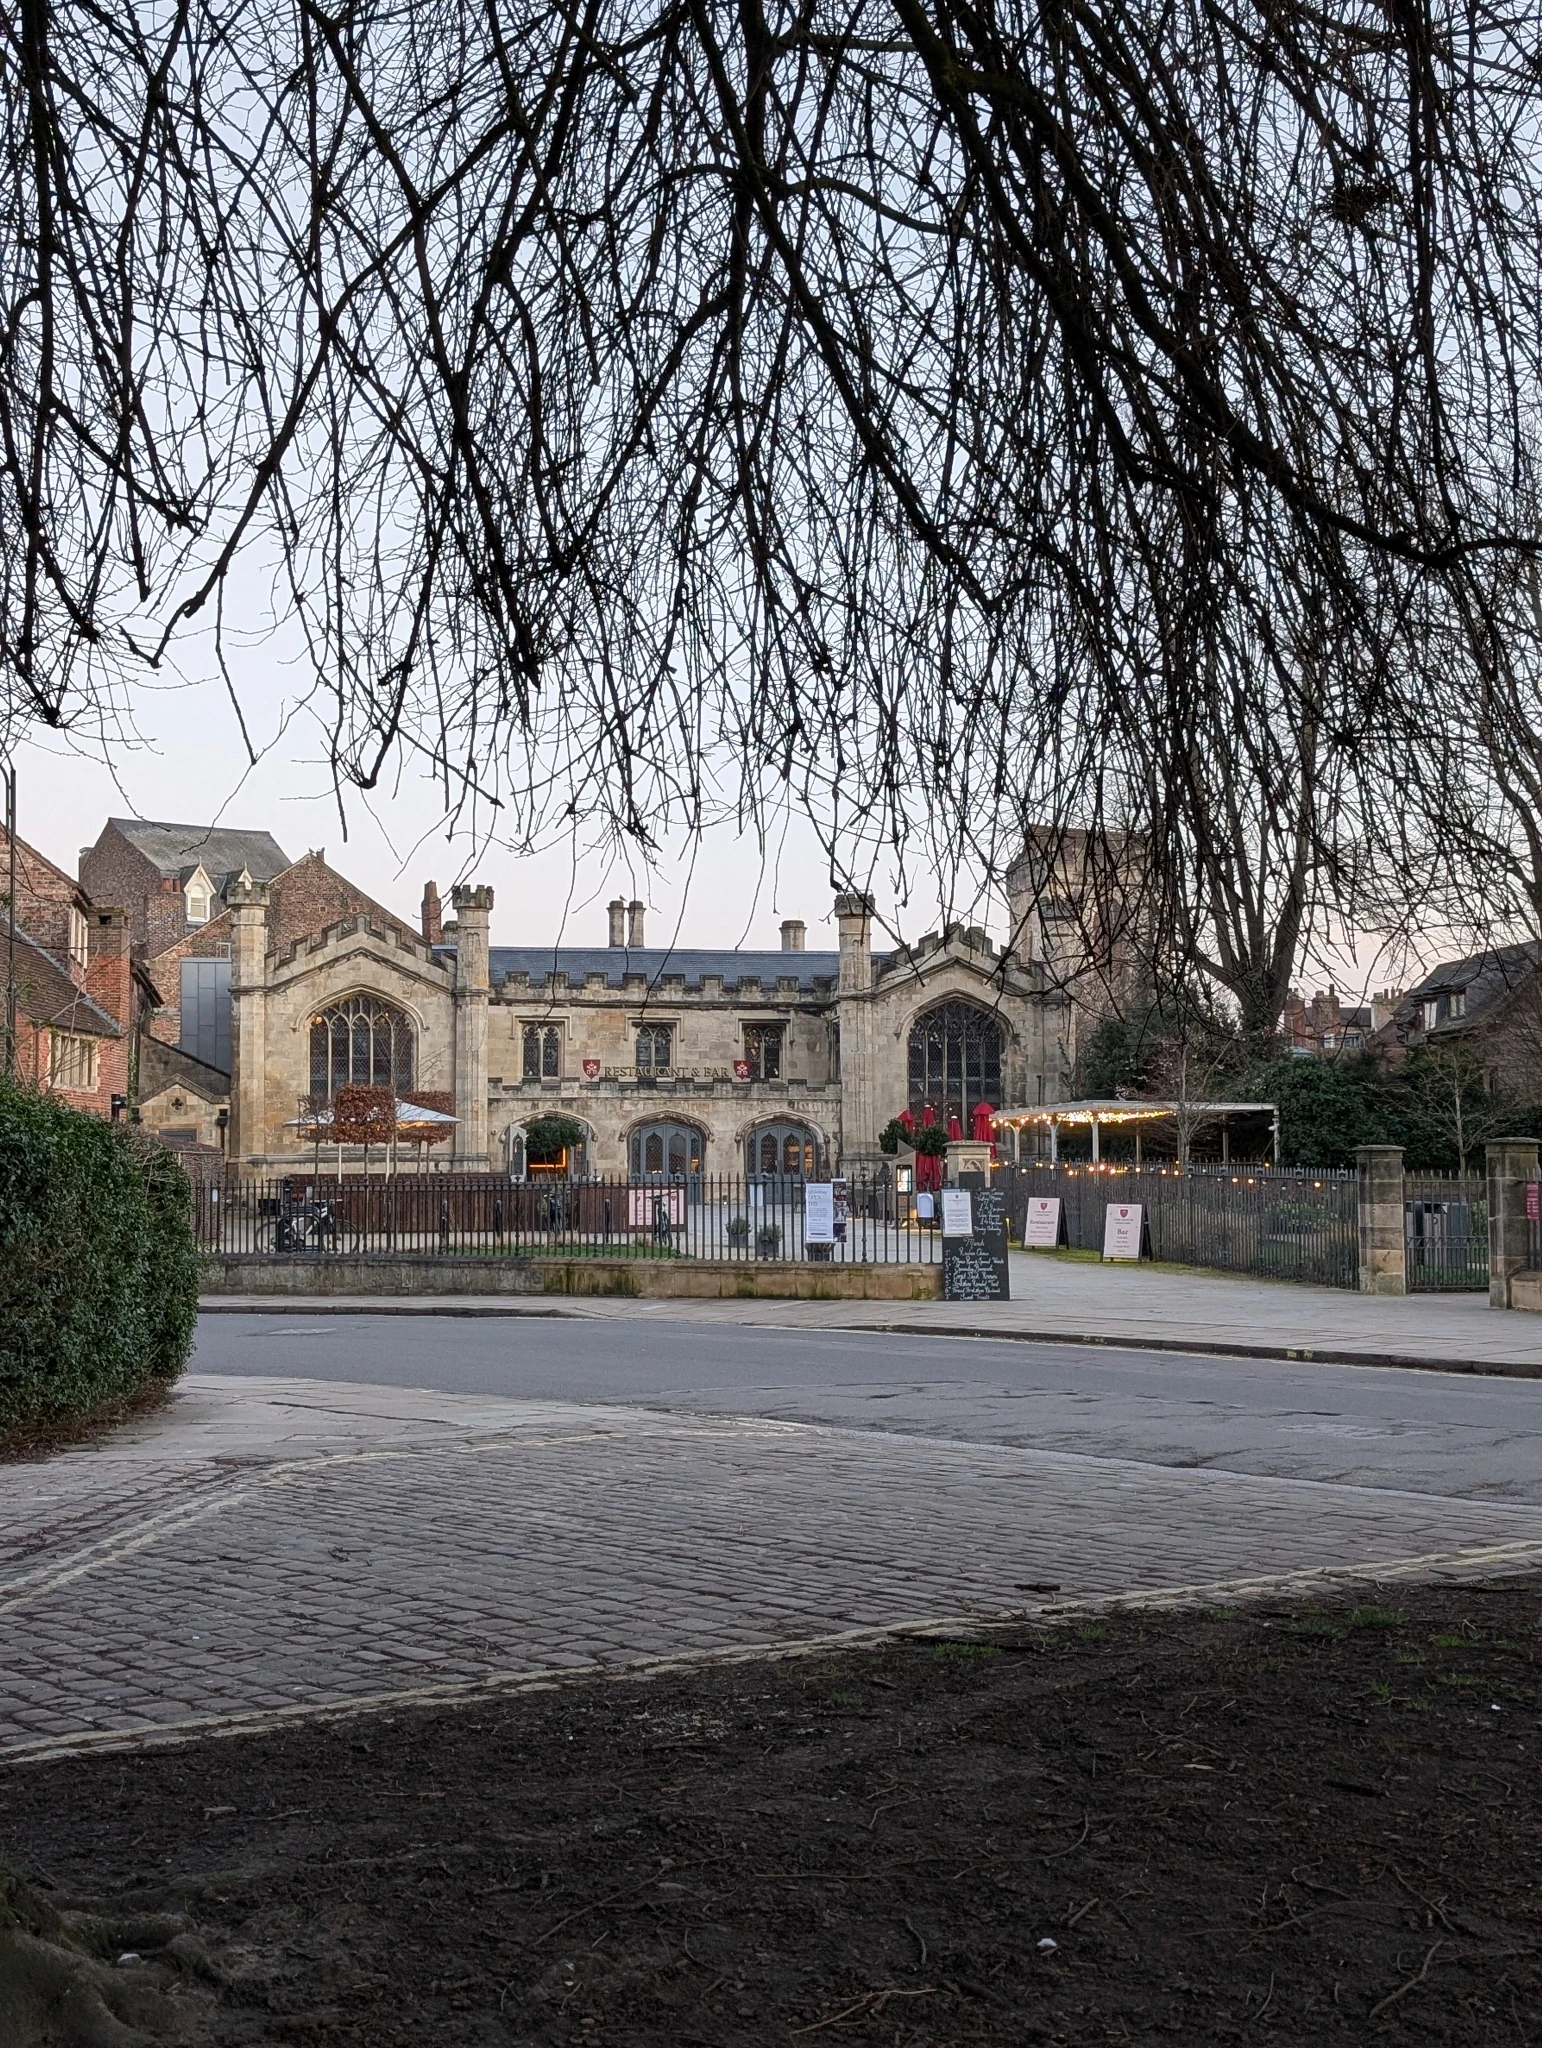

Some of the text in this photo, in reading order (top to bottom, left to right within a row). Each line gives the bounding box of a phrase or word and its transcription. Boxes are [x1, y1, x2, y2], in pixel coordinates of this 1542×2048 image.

[604, 1066, 729, 1078] RESTAURANT & BAR
